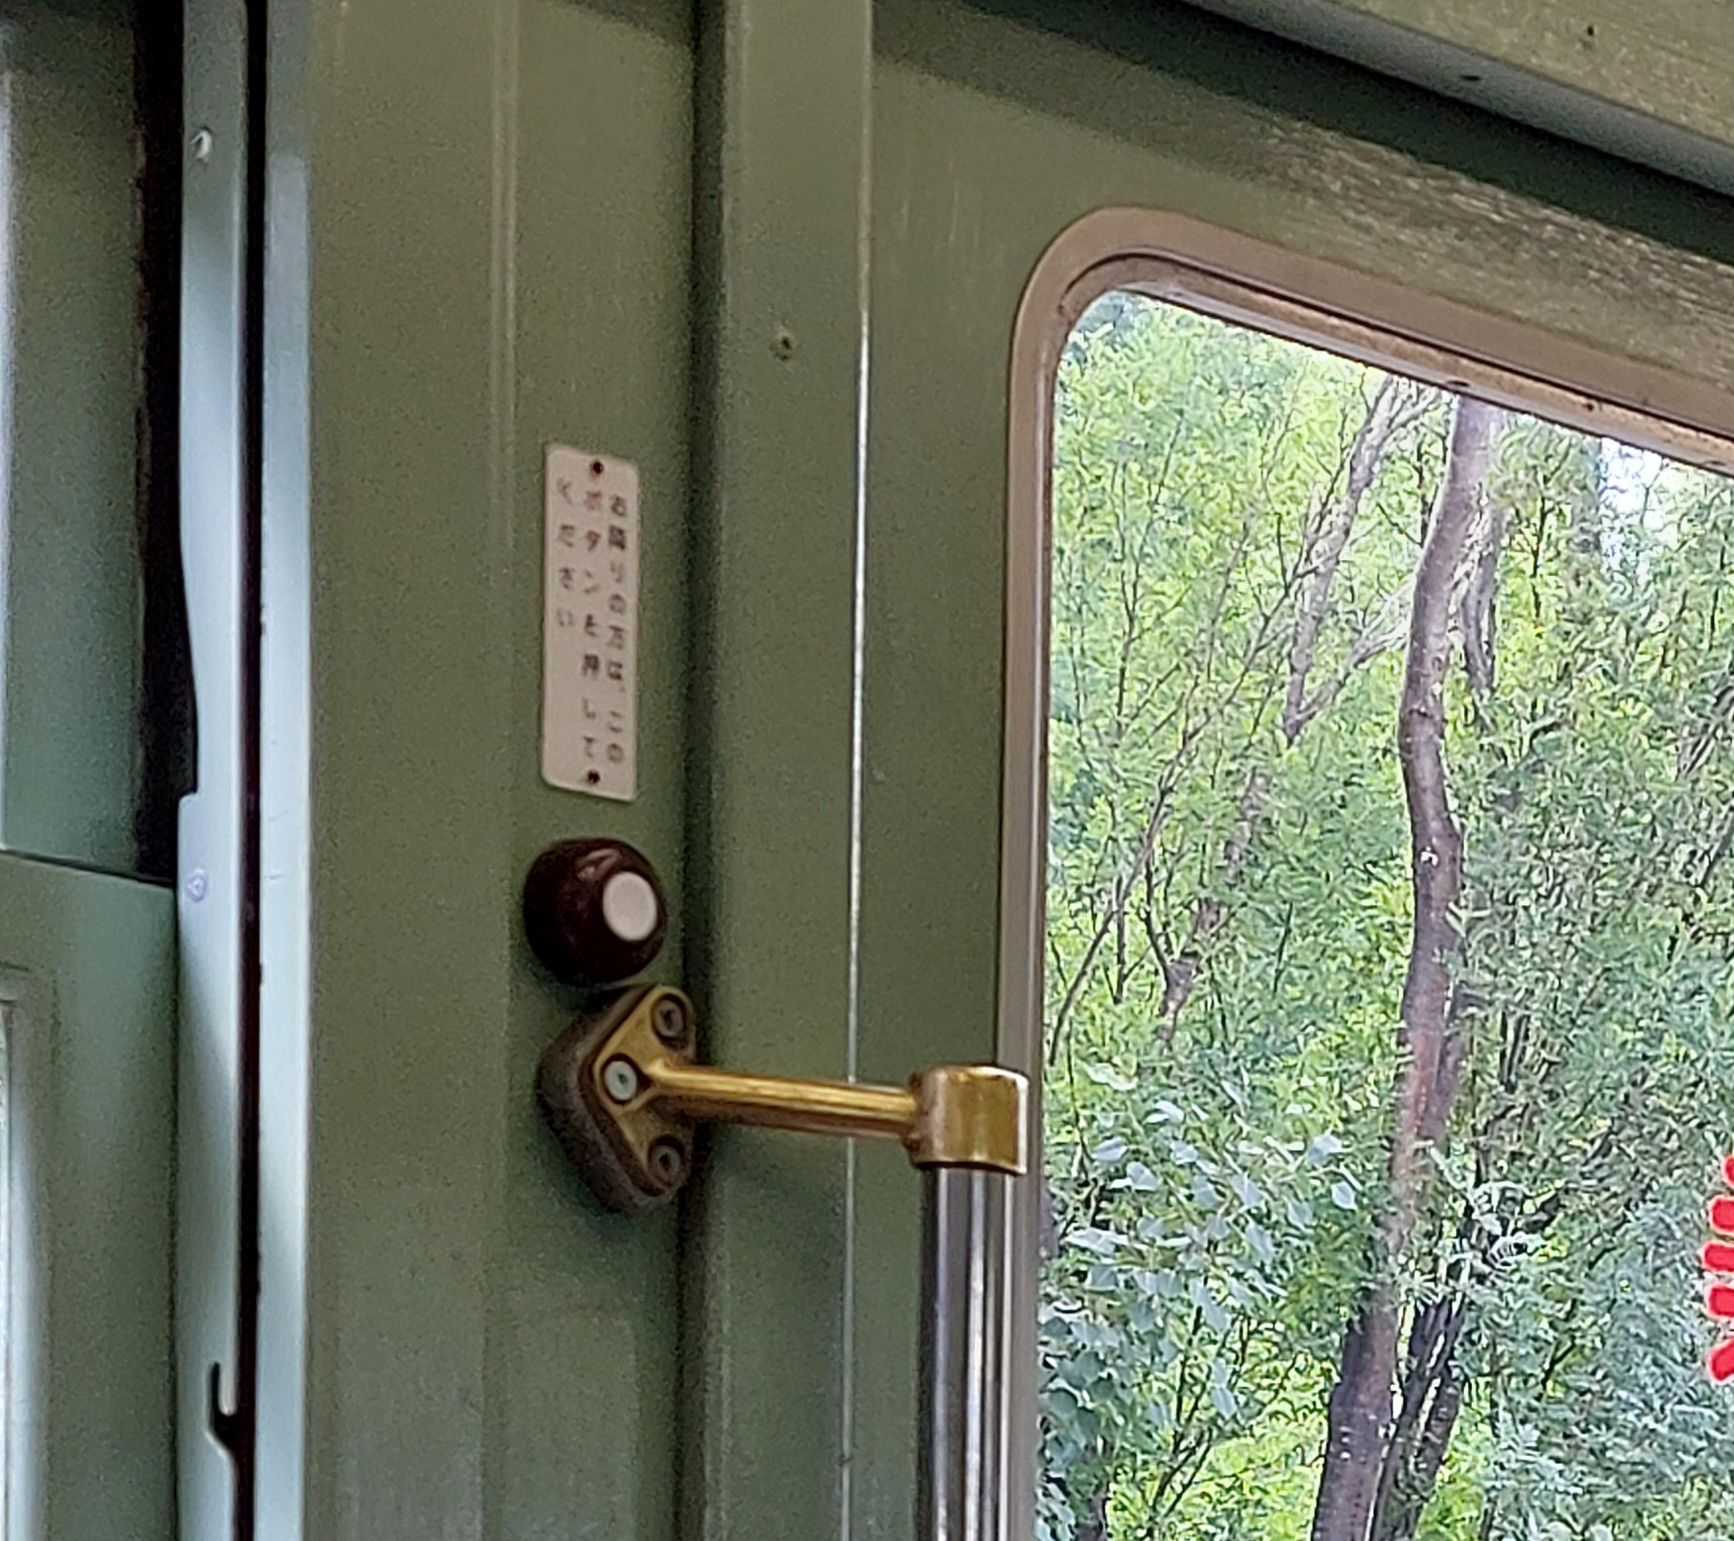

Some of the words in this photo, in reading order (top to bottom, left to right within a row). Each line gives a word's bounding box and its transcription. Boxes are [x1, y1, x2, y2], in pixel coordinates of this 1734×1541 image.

[555, 477, 576, 627] ください
[581, 489, 603, 759] ボタンを押して
